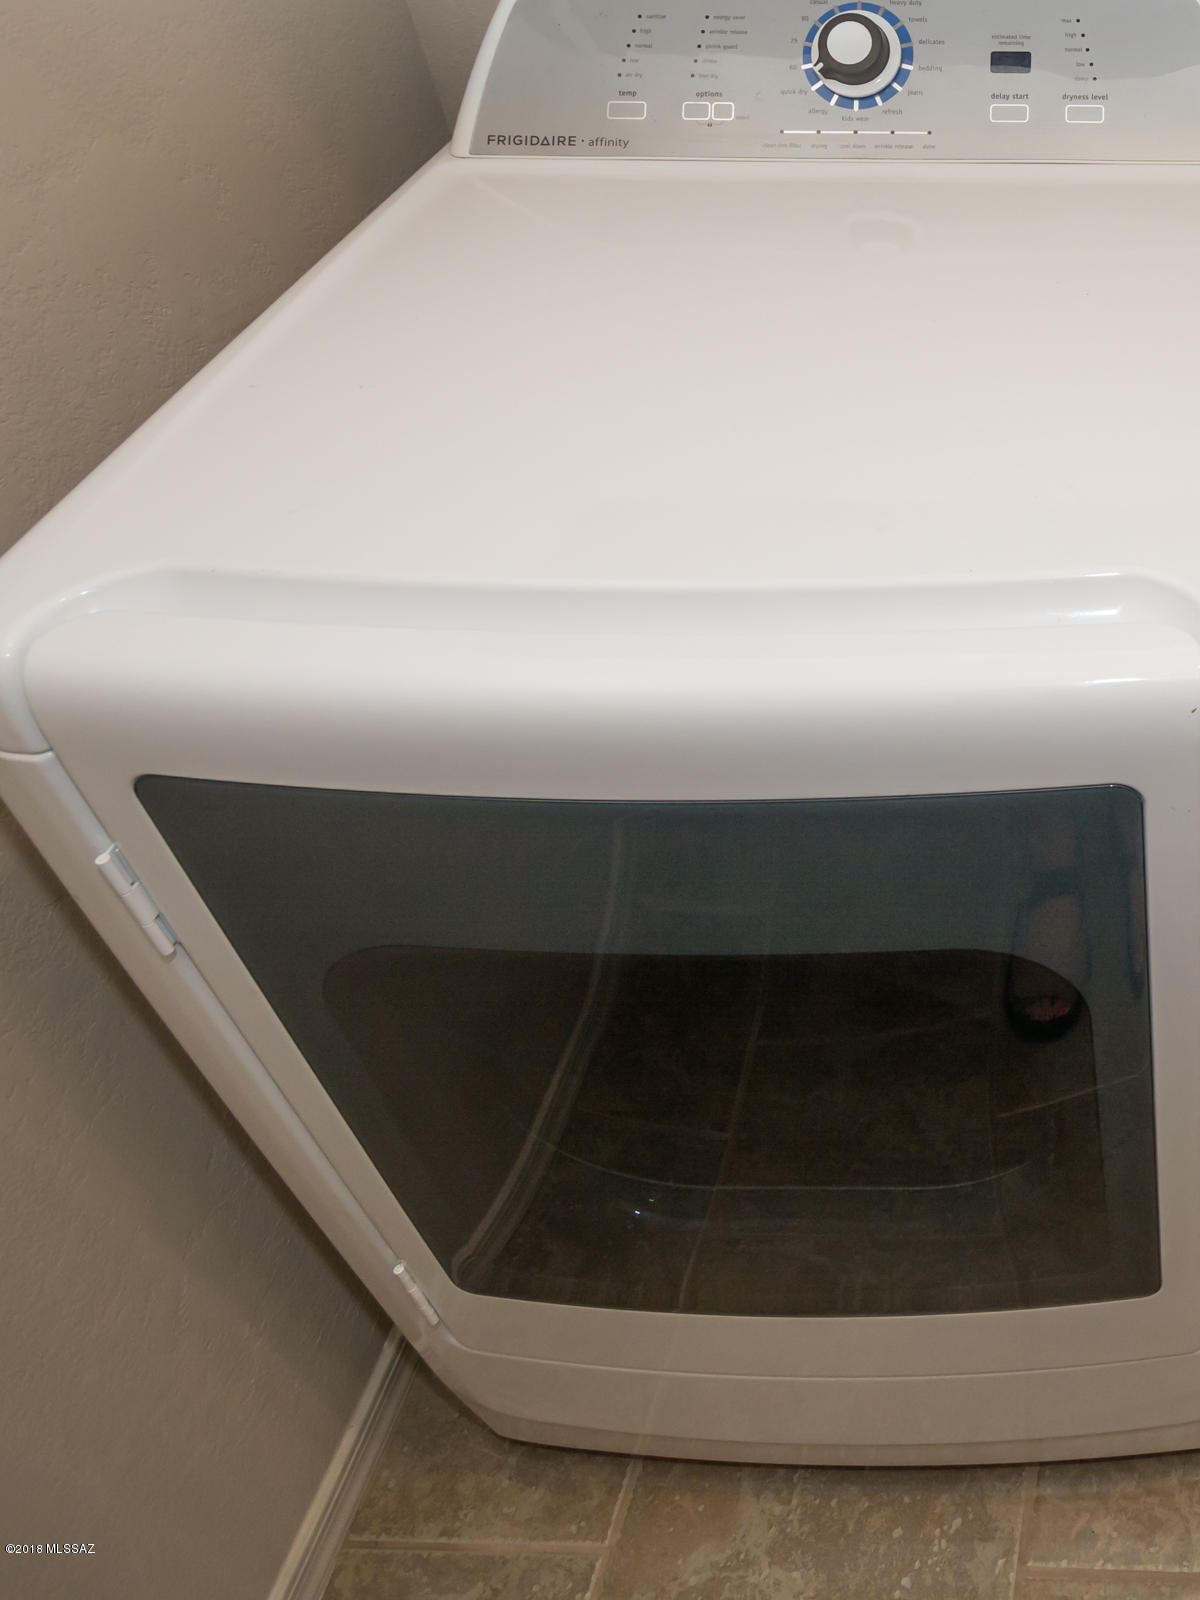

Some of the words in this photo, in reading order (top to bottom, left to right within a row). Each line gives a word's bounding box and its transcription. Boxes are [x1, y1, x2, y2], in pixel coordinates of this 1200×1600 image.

[918, 38, 945, 46] delicates
[918, 64, 942, 73] bedding
[618, 89, 637, 98] temp
[695, 90, 723, 98] options
[780, 88, 797, 96] quick
[798, 88, 809, 96] dry
[907, 88, 924, 97] jeans
[990, 92, 1010, 101] delay
[1011, 92, 1029, 100] start
[1062, 93, 1089, 102] dryness
[1090, 93, 1108, 101] level
[808, 108, 829, 116] allergy
[881, 108, 903, 116] refresh
[487, 134, 577, 147] FRIGIDAIRE
[588, 136, 630, 149] affinity
